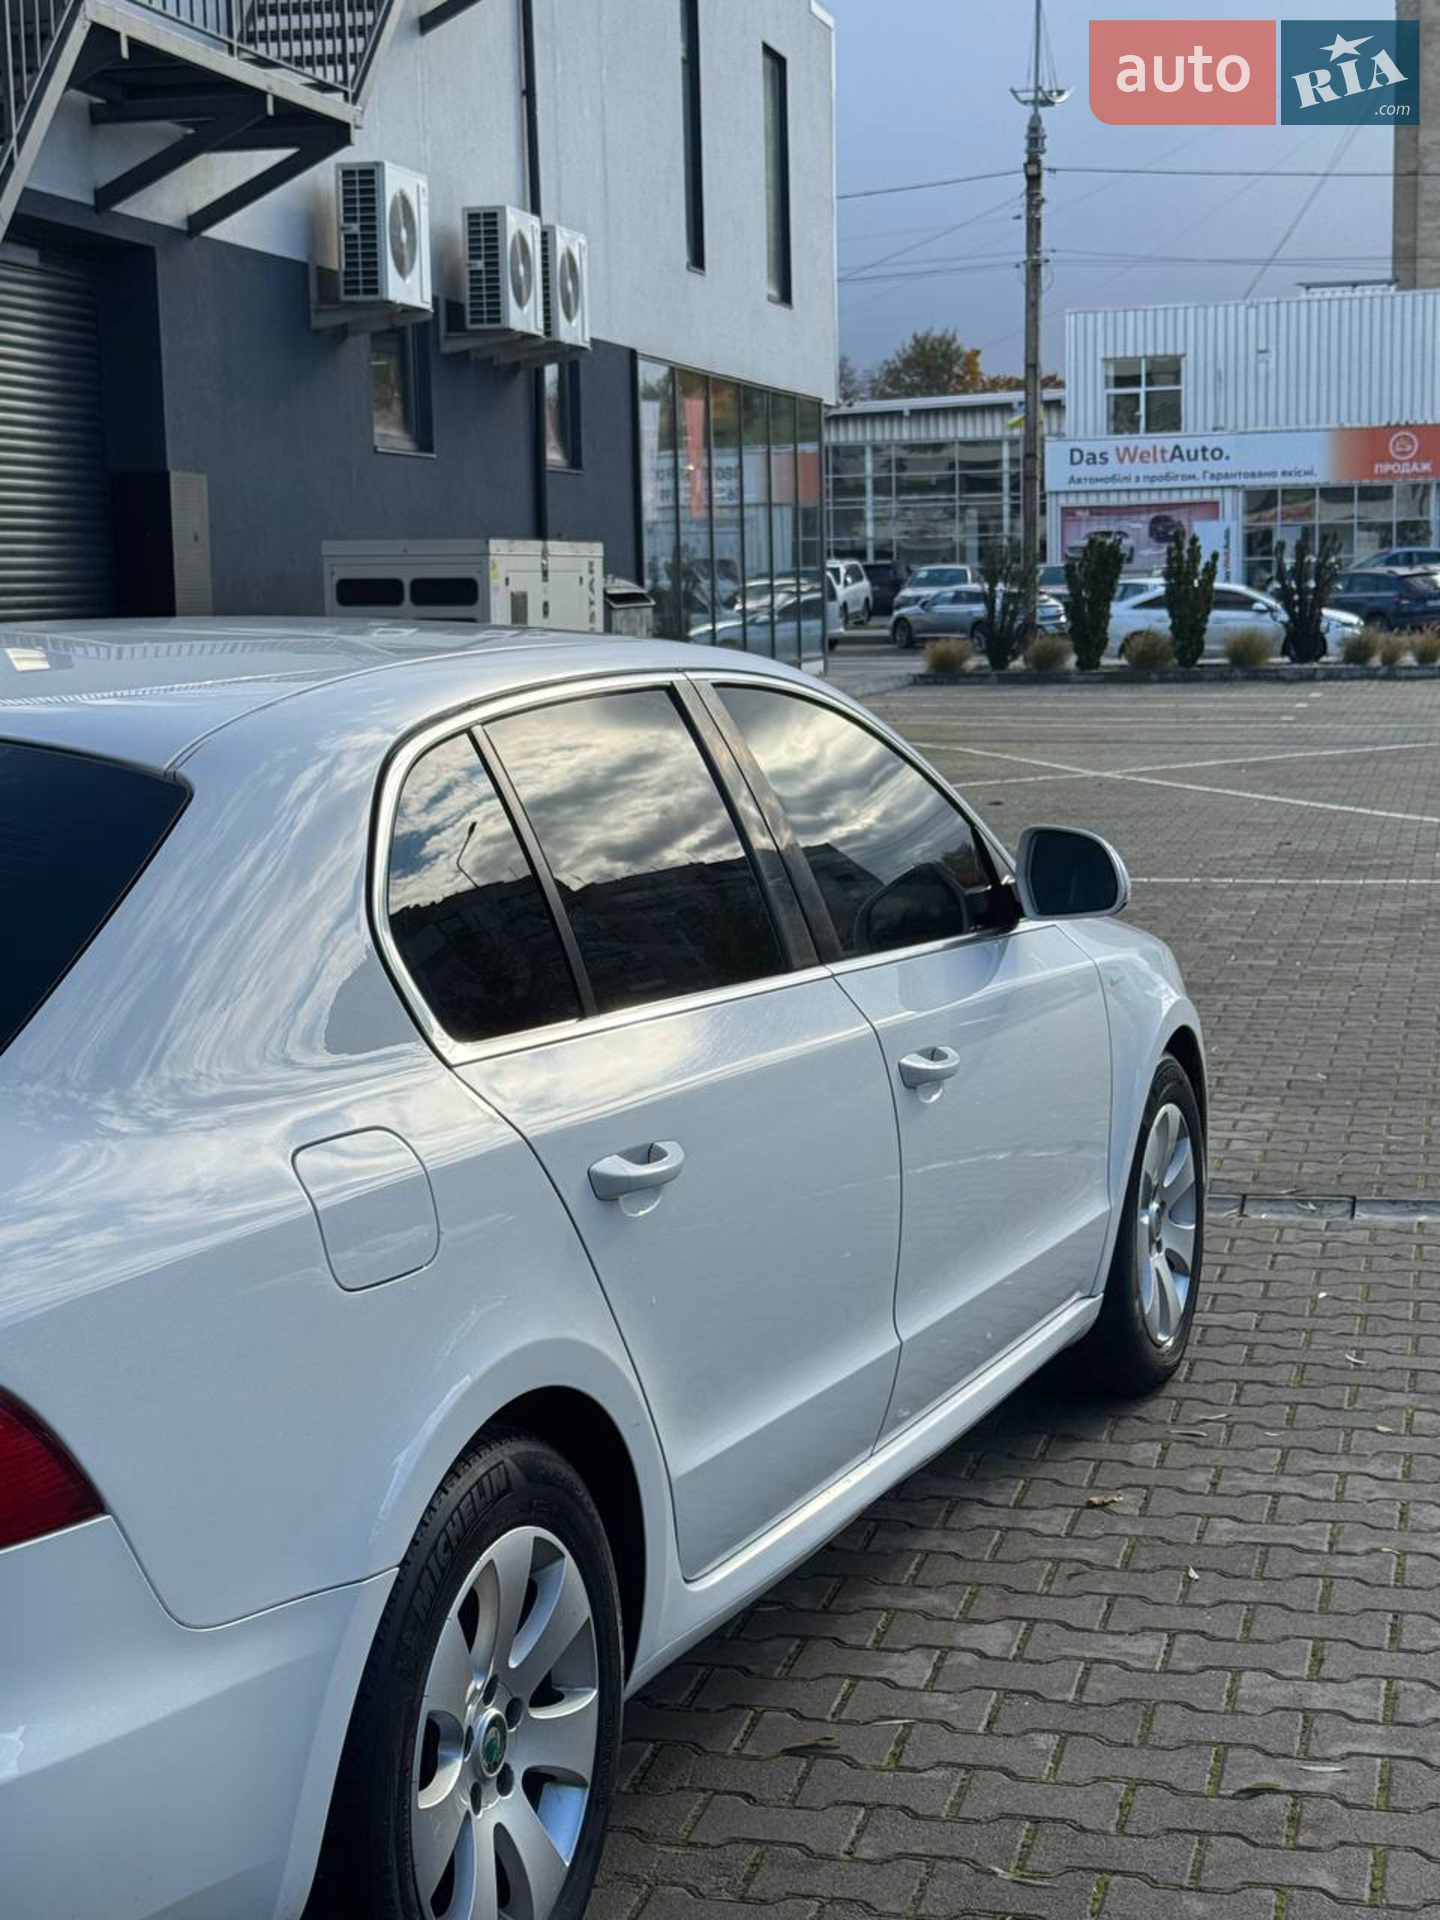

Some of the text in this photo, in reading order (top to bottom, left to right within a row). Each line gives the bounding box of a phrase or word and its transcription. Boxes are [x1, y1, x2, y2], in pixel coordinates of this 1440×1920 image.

[1069, 444, 1231, 466] Das WeltAuto.
[1068, 473, 1132, 485] Автомобілі
[1202, 469, 1279, 483] Гарантовано
[1373, 461, 1433, 475] ПРОДАЖ
[412, 1461, 510, 1622] MICHELIN
